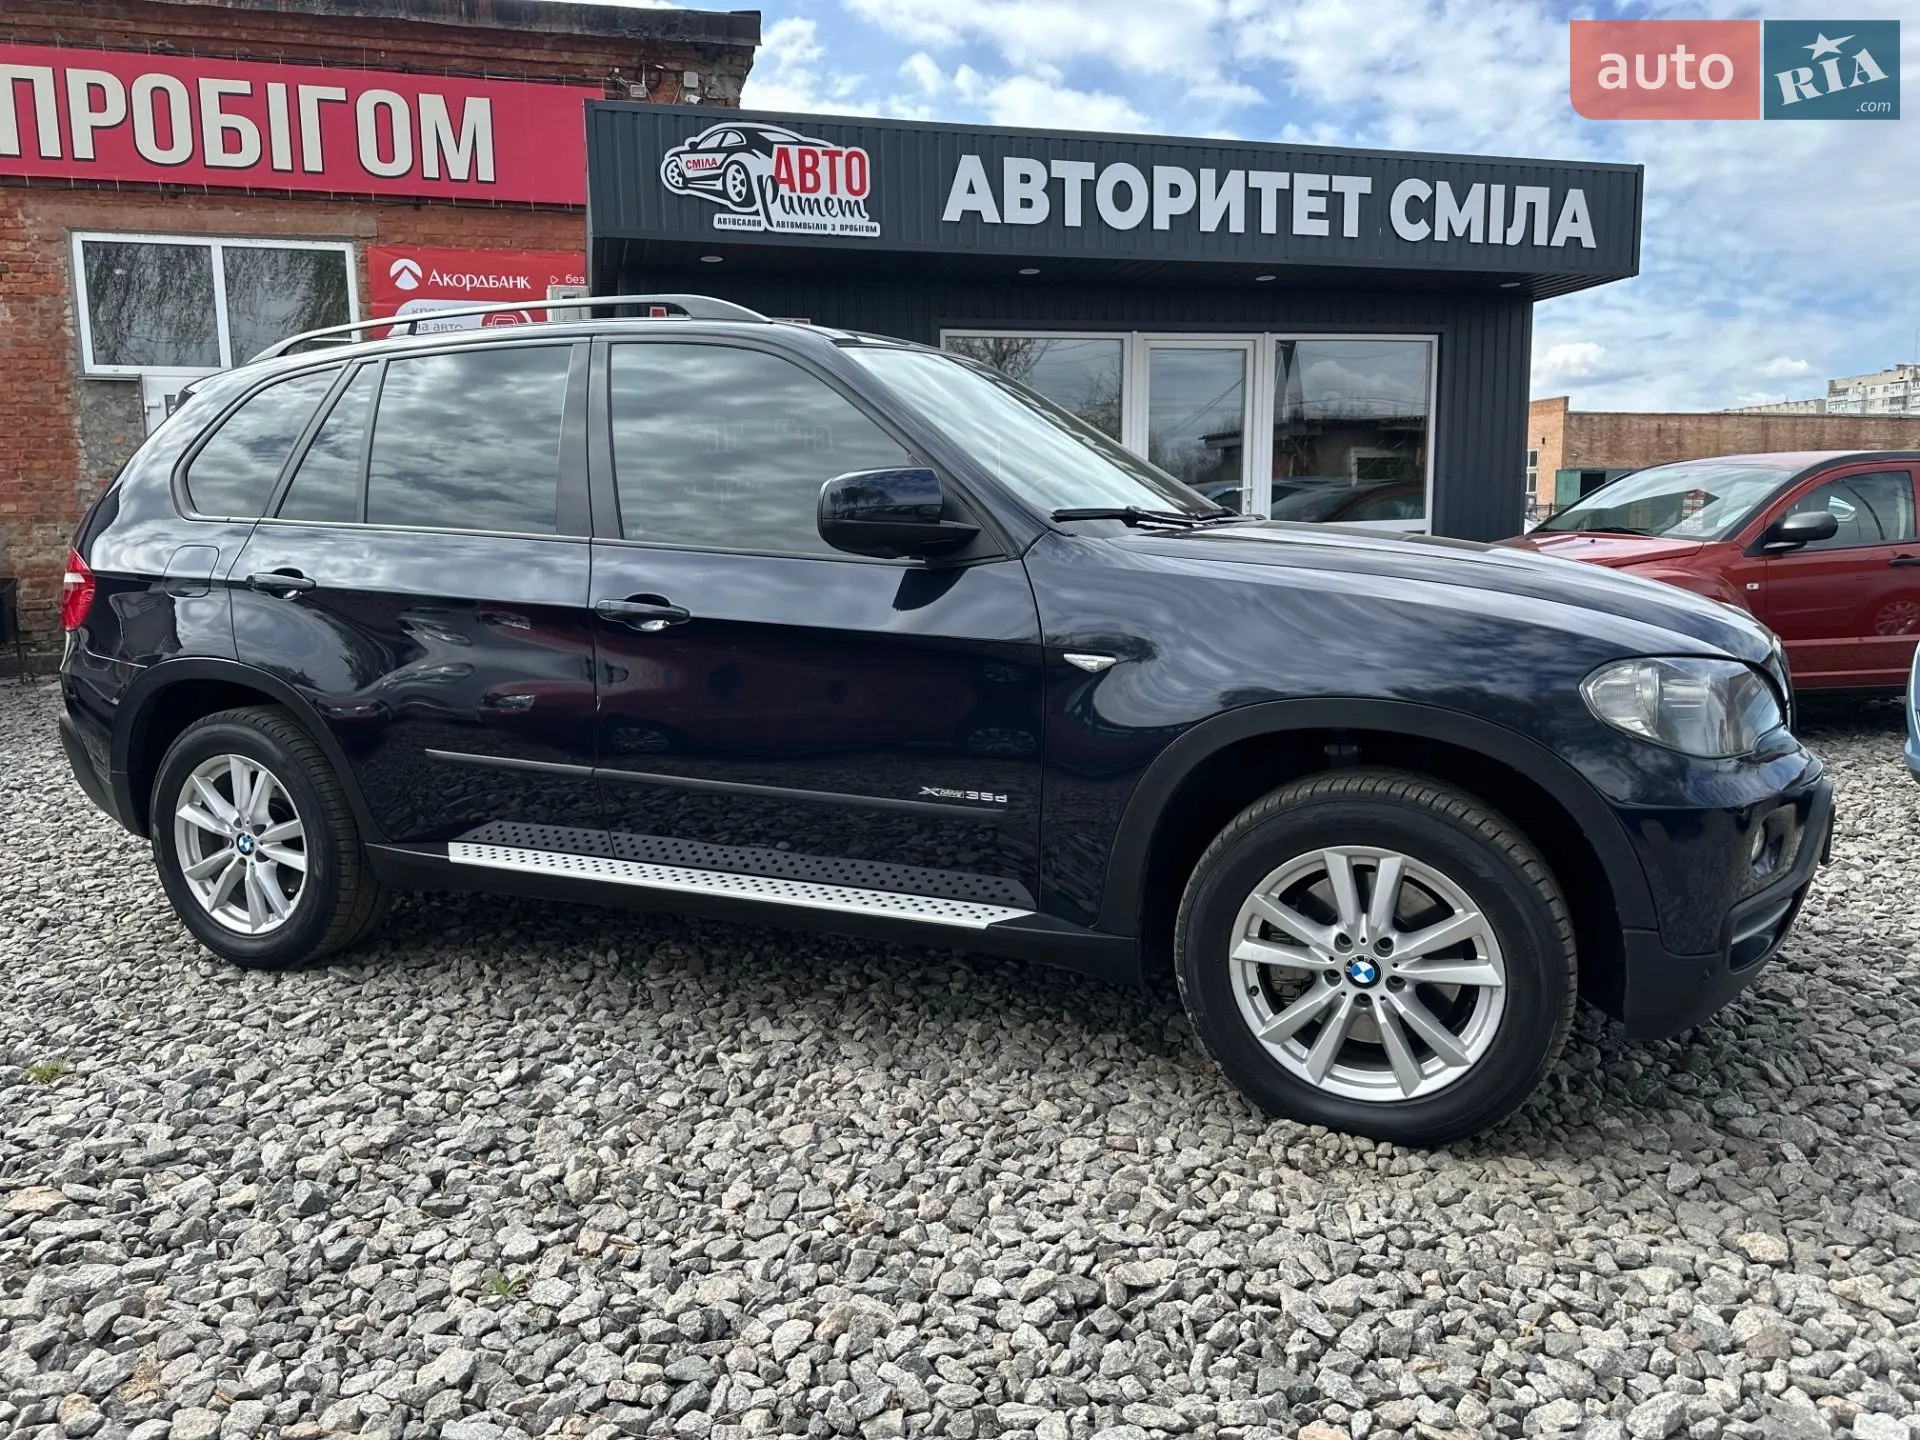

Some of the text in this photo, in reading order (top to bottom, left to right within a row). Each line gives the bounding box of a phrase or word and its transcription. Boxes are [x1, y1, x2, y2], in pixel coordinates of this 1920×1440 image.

[0, 64, 496, 183] ПРОБІГОМ
[685, 157, 718, 170] СМІЛА
[774, 147, 868, 197] АВТО
[941, 154, 1597, 249] АВТОРИТЕТ СМІЛА
[717, 217, 762, 228] АВТОСАЛОН
[839, 223, 877, 233] ПРОБІГОМ
[565, 274, 586, 285] без
